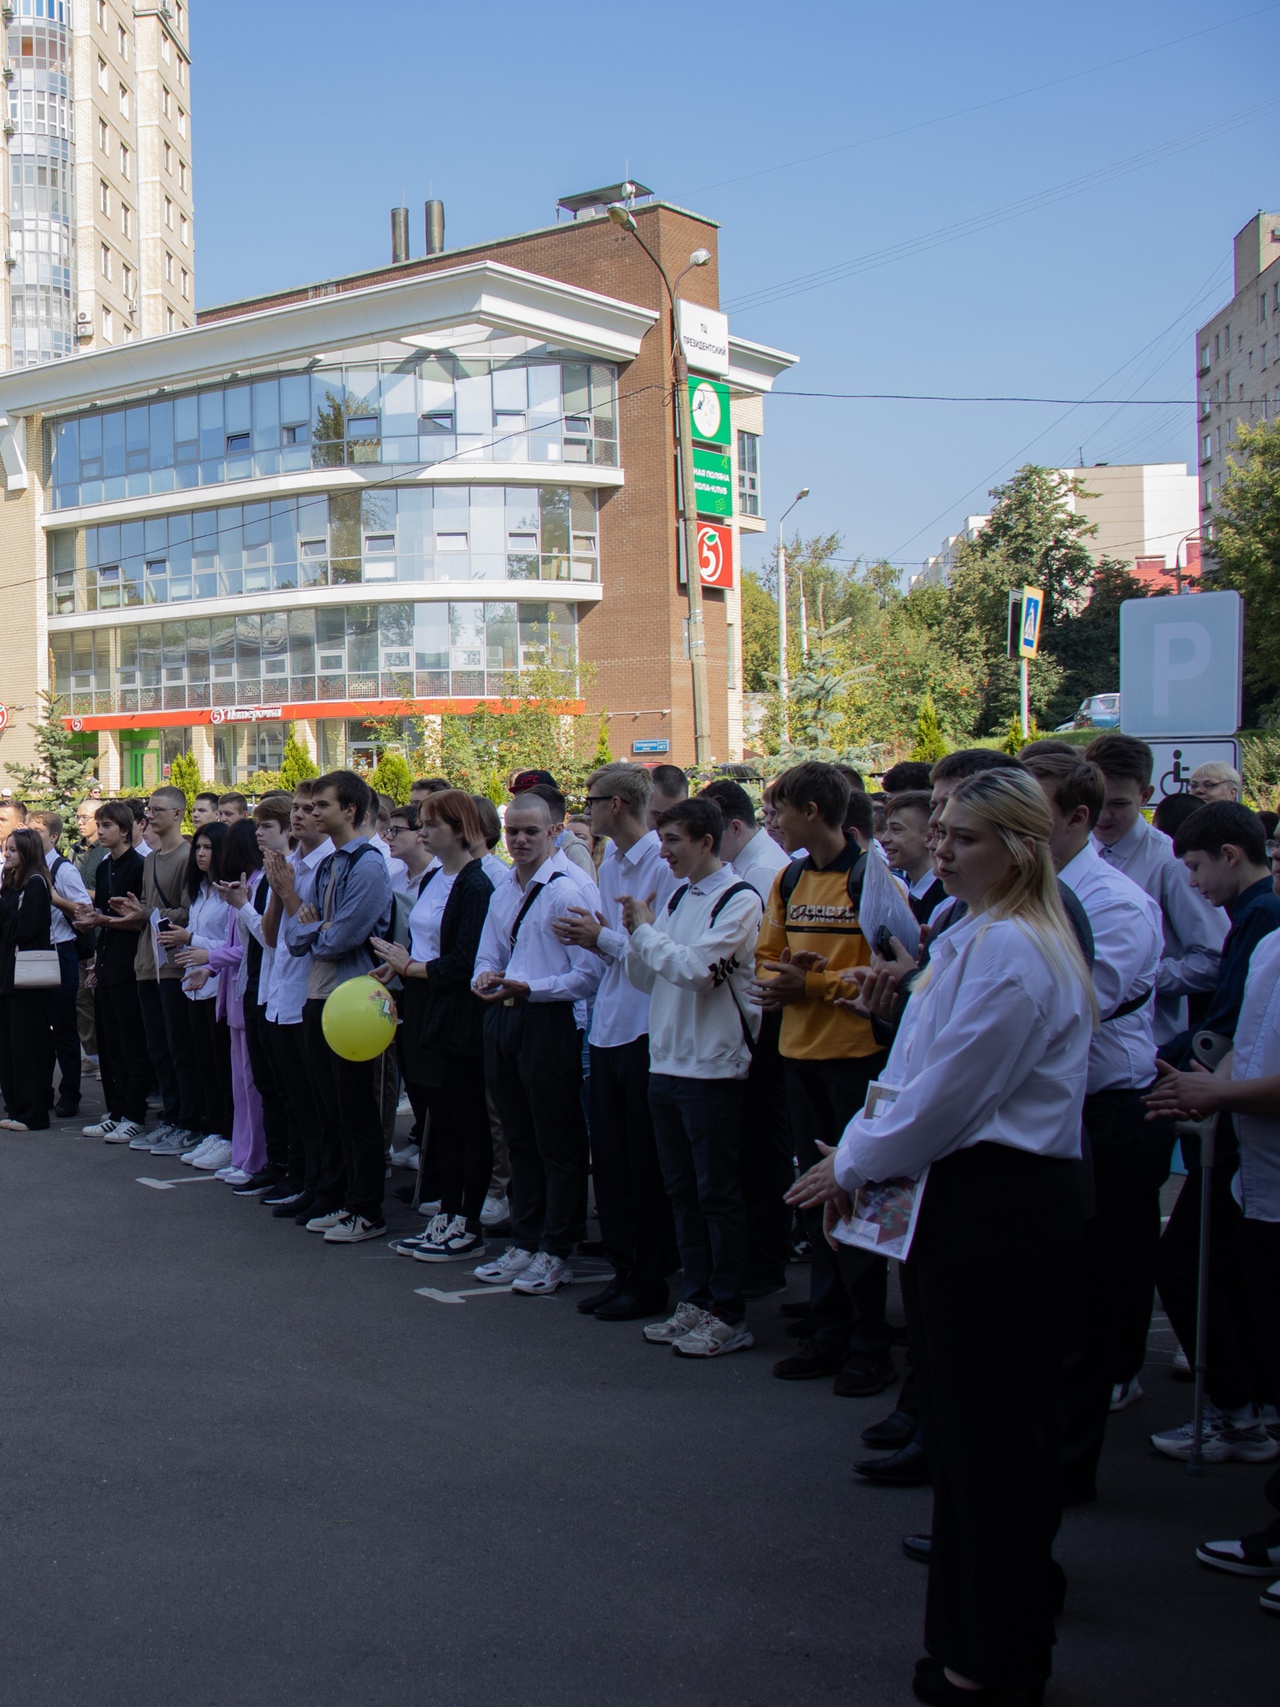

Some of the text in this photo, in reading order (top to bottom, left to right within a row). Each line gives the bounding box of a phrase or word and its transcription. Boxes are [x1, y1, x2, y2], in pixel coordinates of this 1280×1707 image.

[700, 323, 708, 334] ТЦ
[683, 335, 727, 356] ПРЕЗИДЕНТСКИЙ
[706, 470, 730, 482] ПОЛЯНА
[1153, 621, 1211, 716] P
[521, 775, 539, 784] UFC
